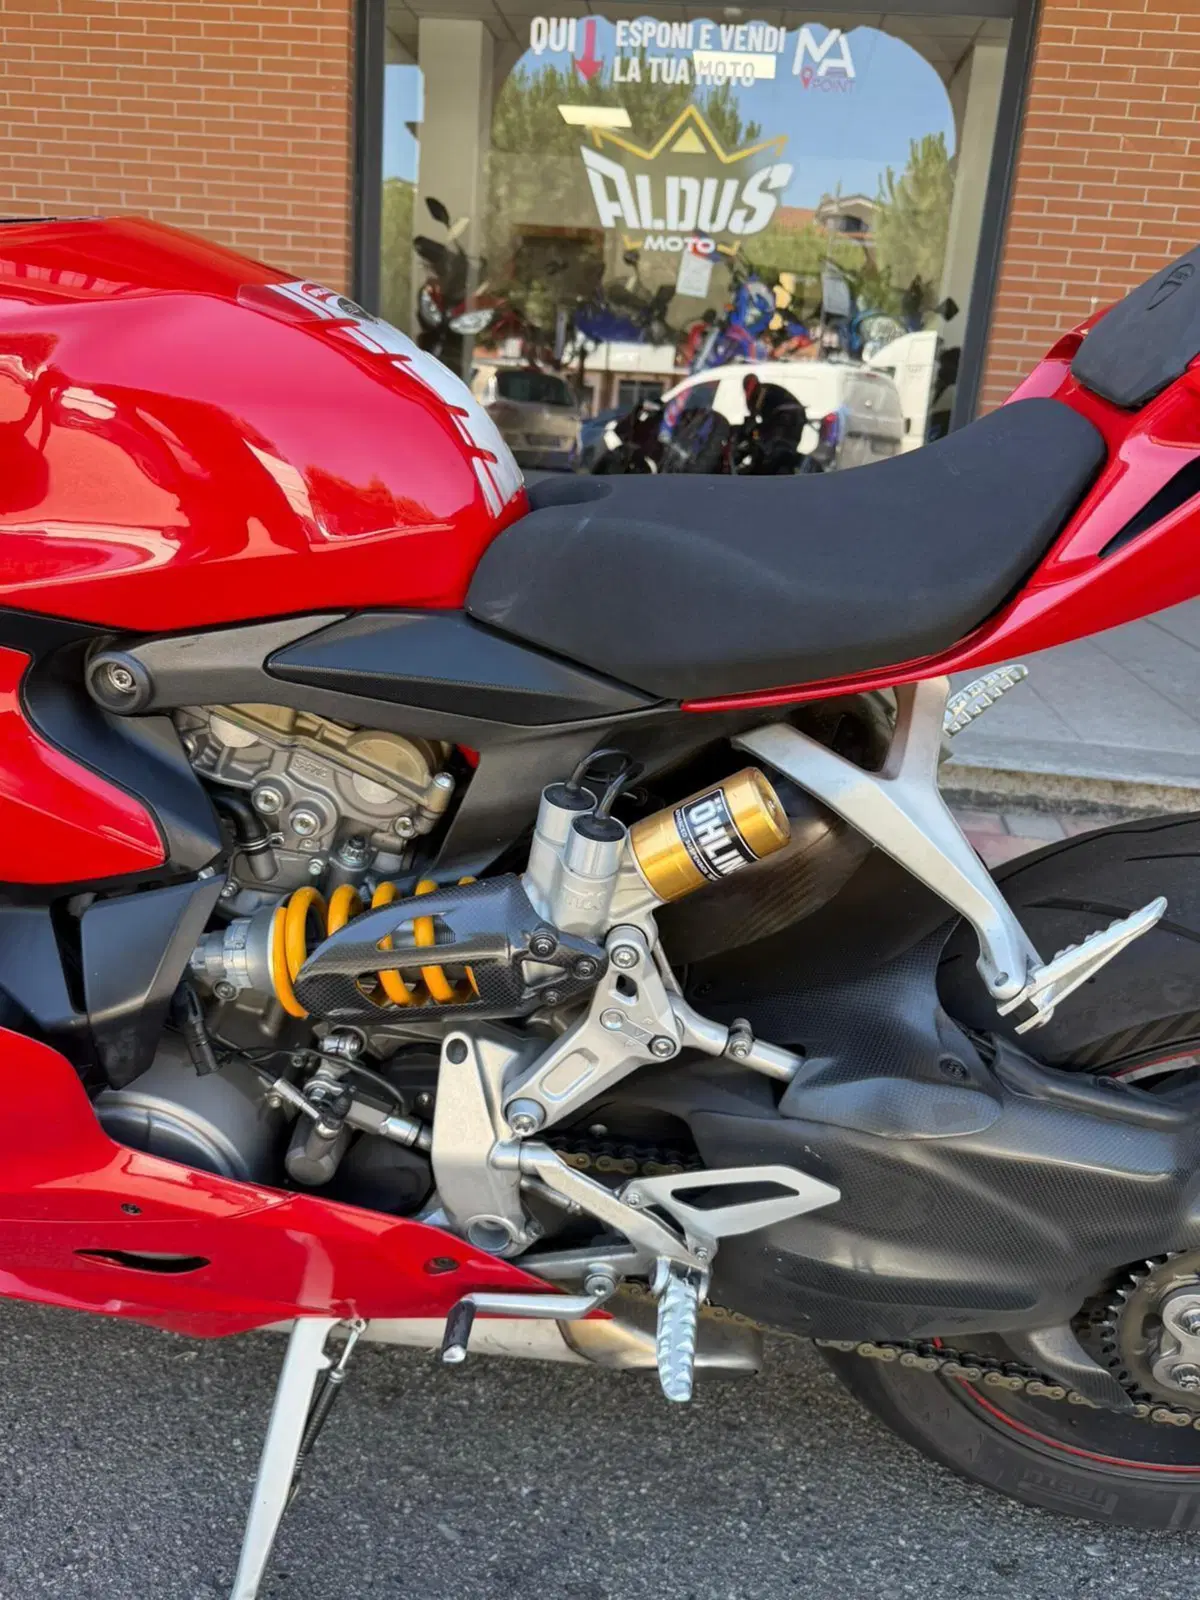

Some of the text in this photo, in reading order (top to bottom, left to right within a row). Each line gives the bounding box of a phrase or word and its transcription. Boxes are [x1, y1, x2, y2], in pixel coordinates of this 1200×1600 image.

[530, 16, 577, 55] QUI
[615, 20, 787, 53] ESPONI E VENDI
[613, 56, 756, 87] LA TUA MOTO
[580, 145, 793, 235] ALDUS
[644, 236, 716, 254] MOTO
[688, 797, 749, 876] ÖHLIN
